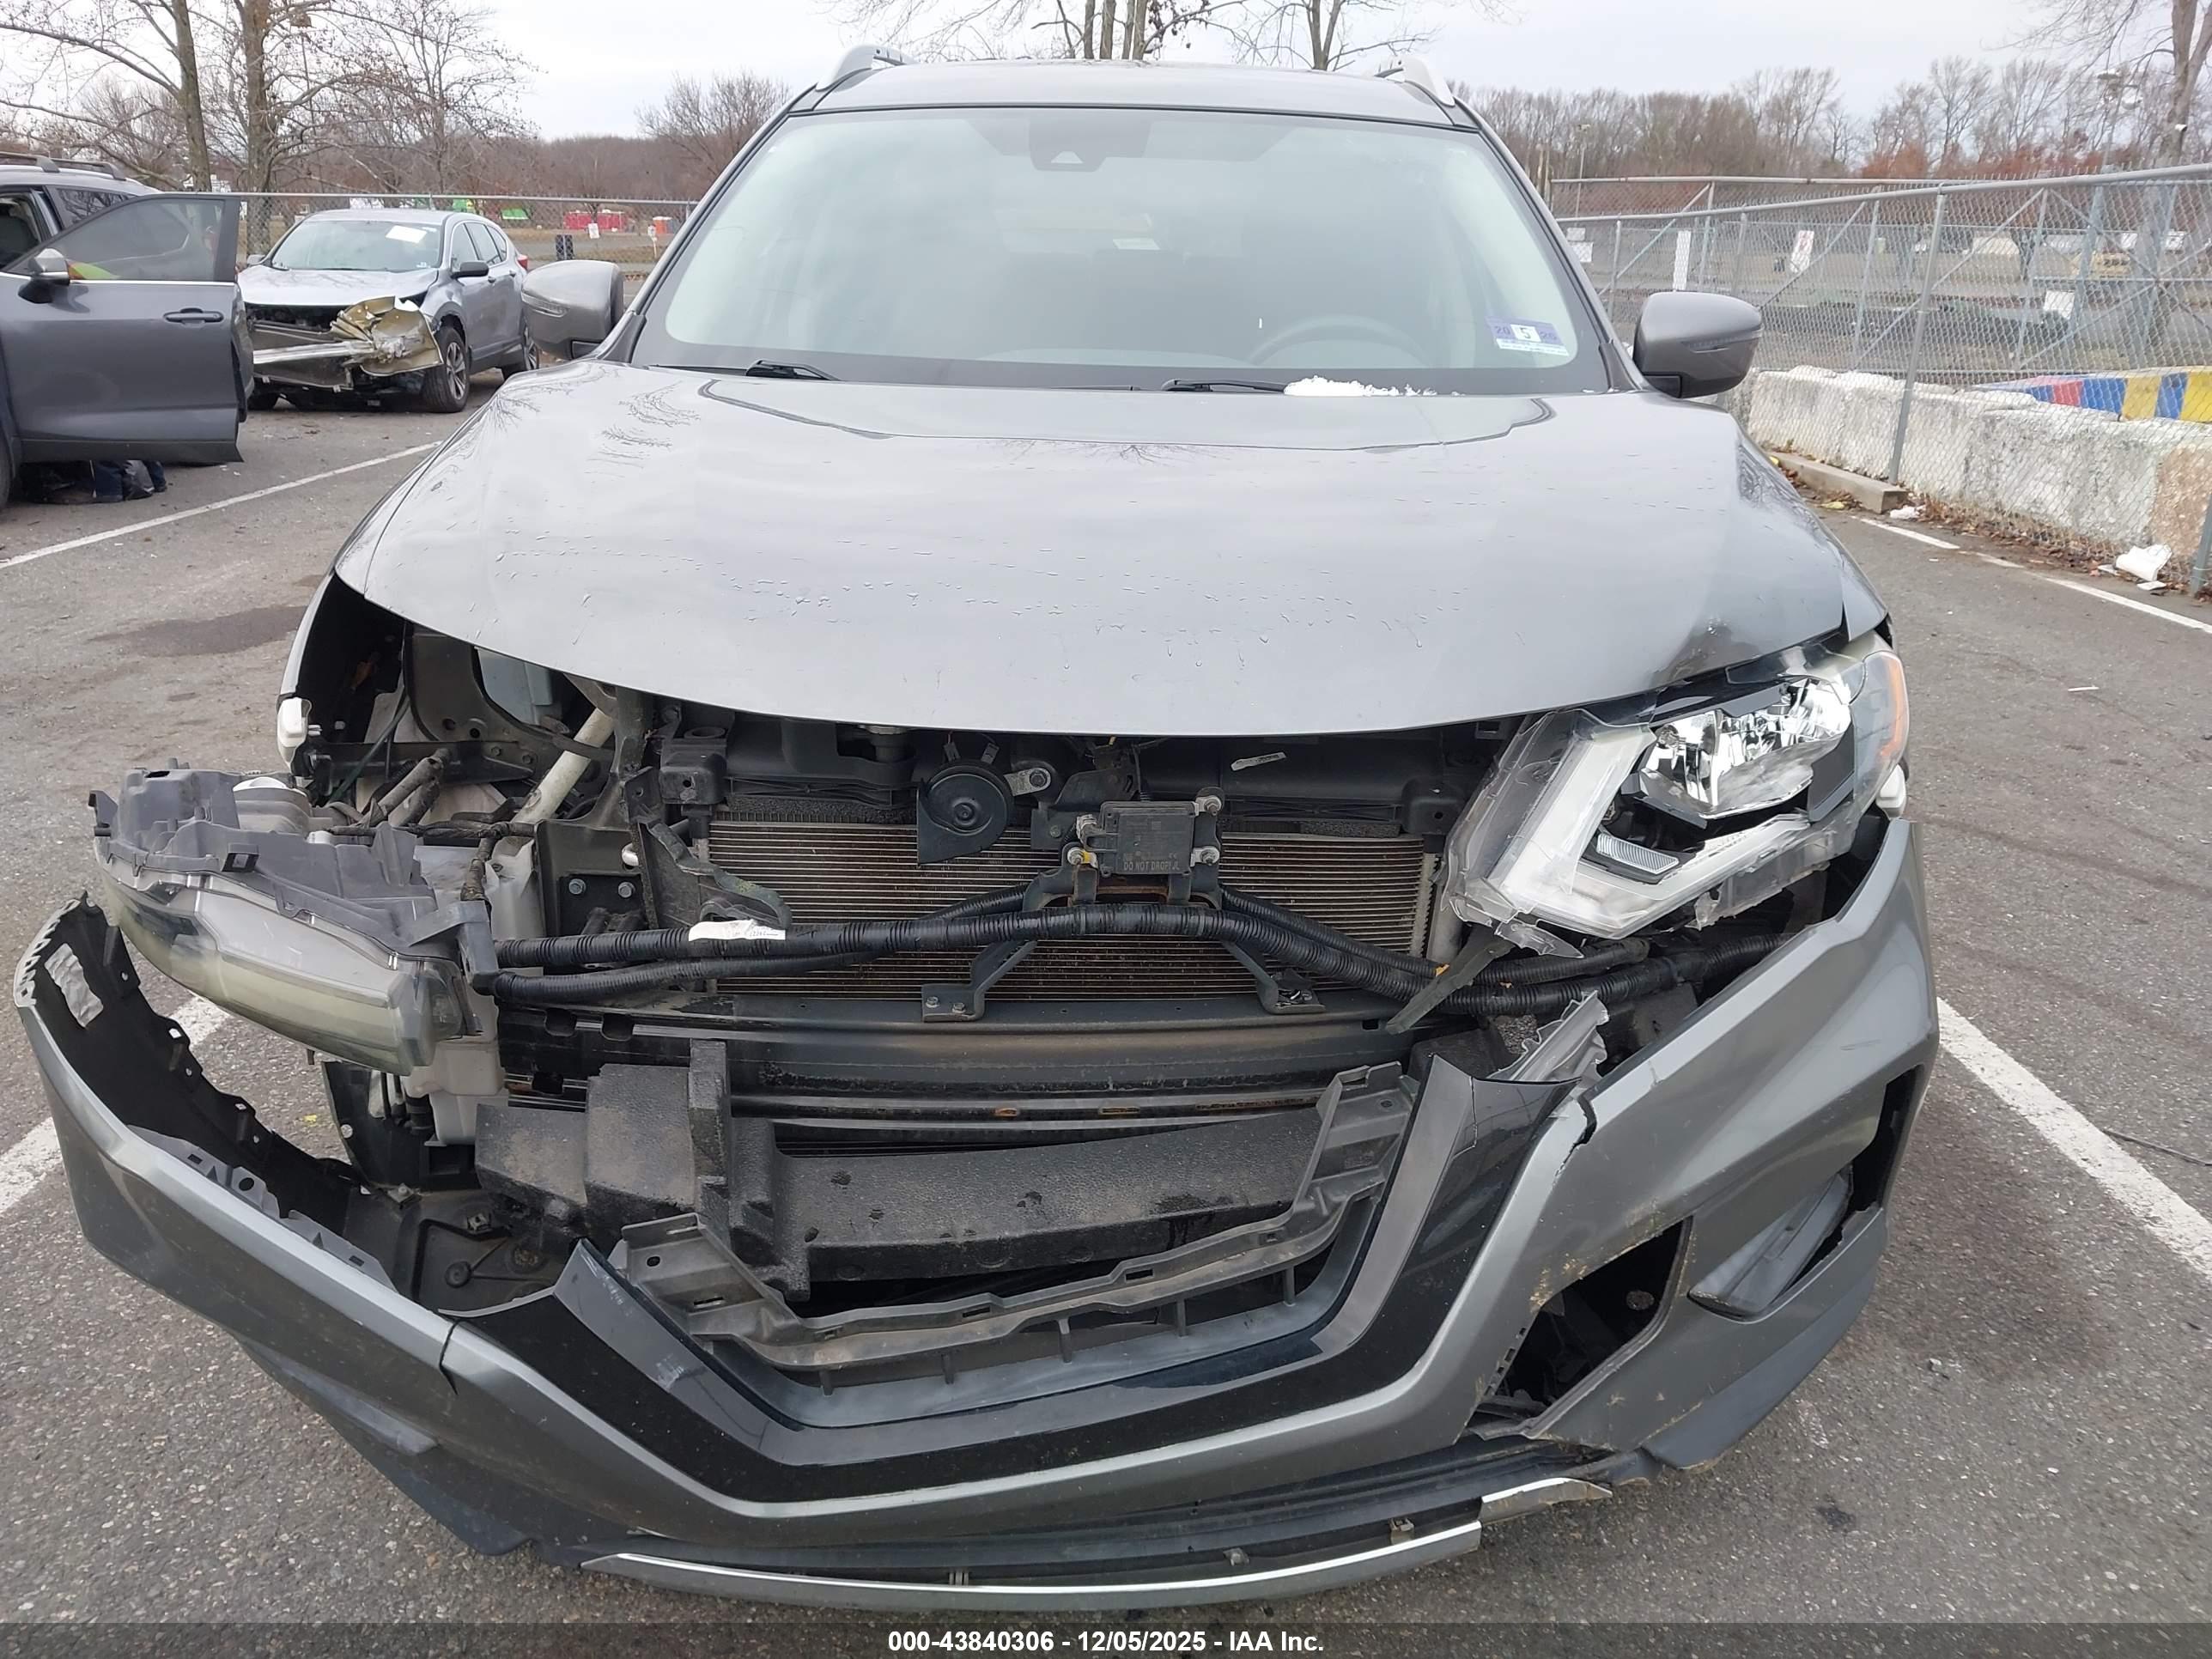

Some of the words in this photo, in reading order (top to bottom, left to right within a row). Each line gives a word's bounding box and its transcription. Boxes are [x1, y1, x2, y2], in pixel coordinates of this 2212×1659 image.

[1519, 326, 1532, 340] 5
[1123, 861, 1133, 871] DO
[1135, 861, 1150, 871] NOT
